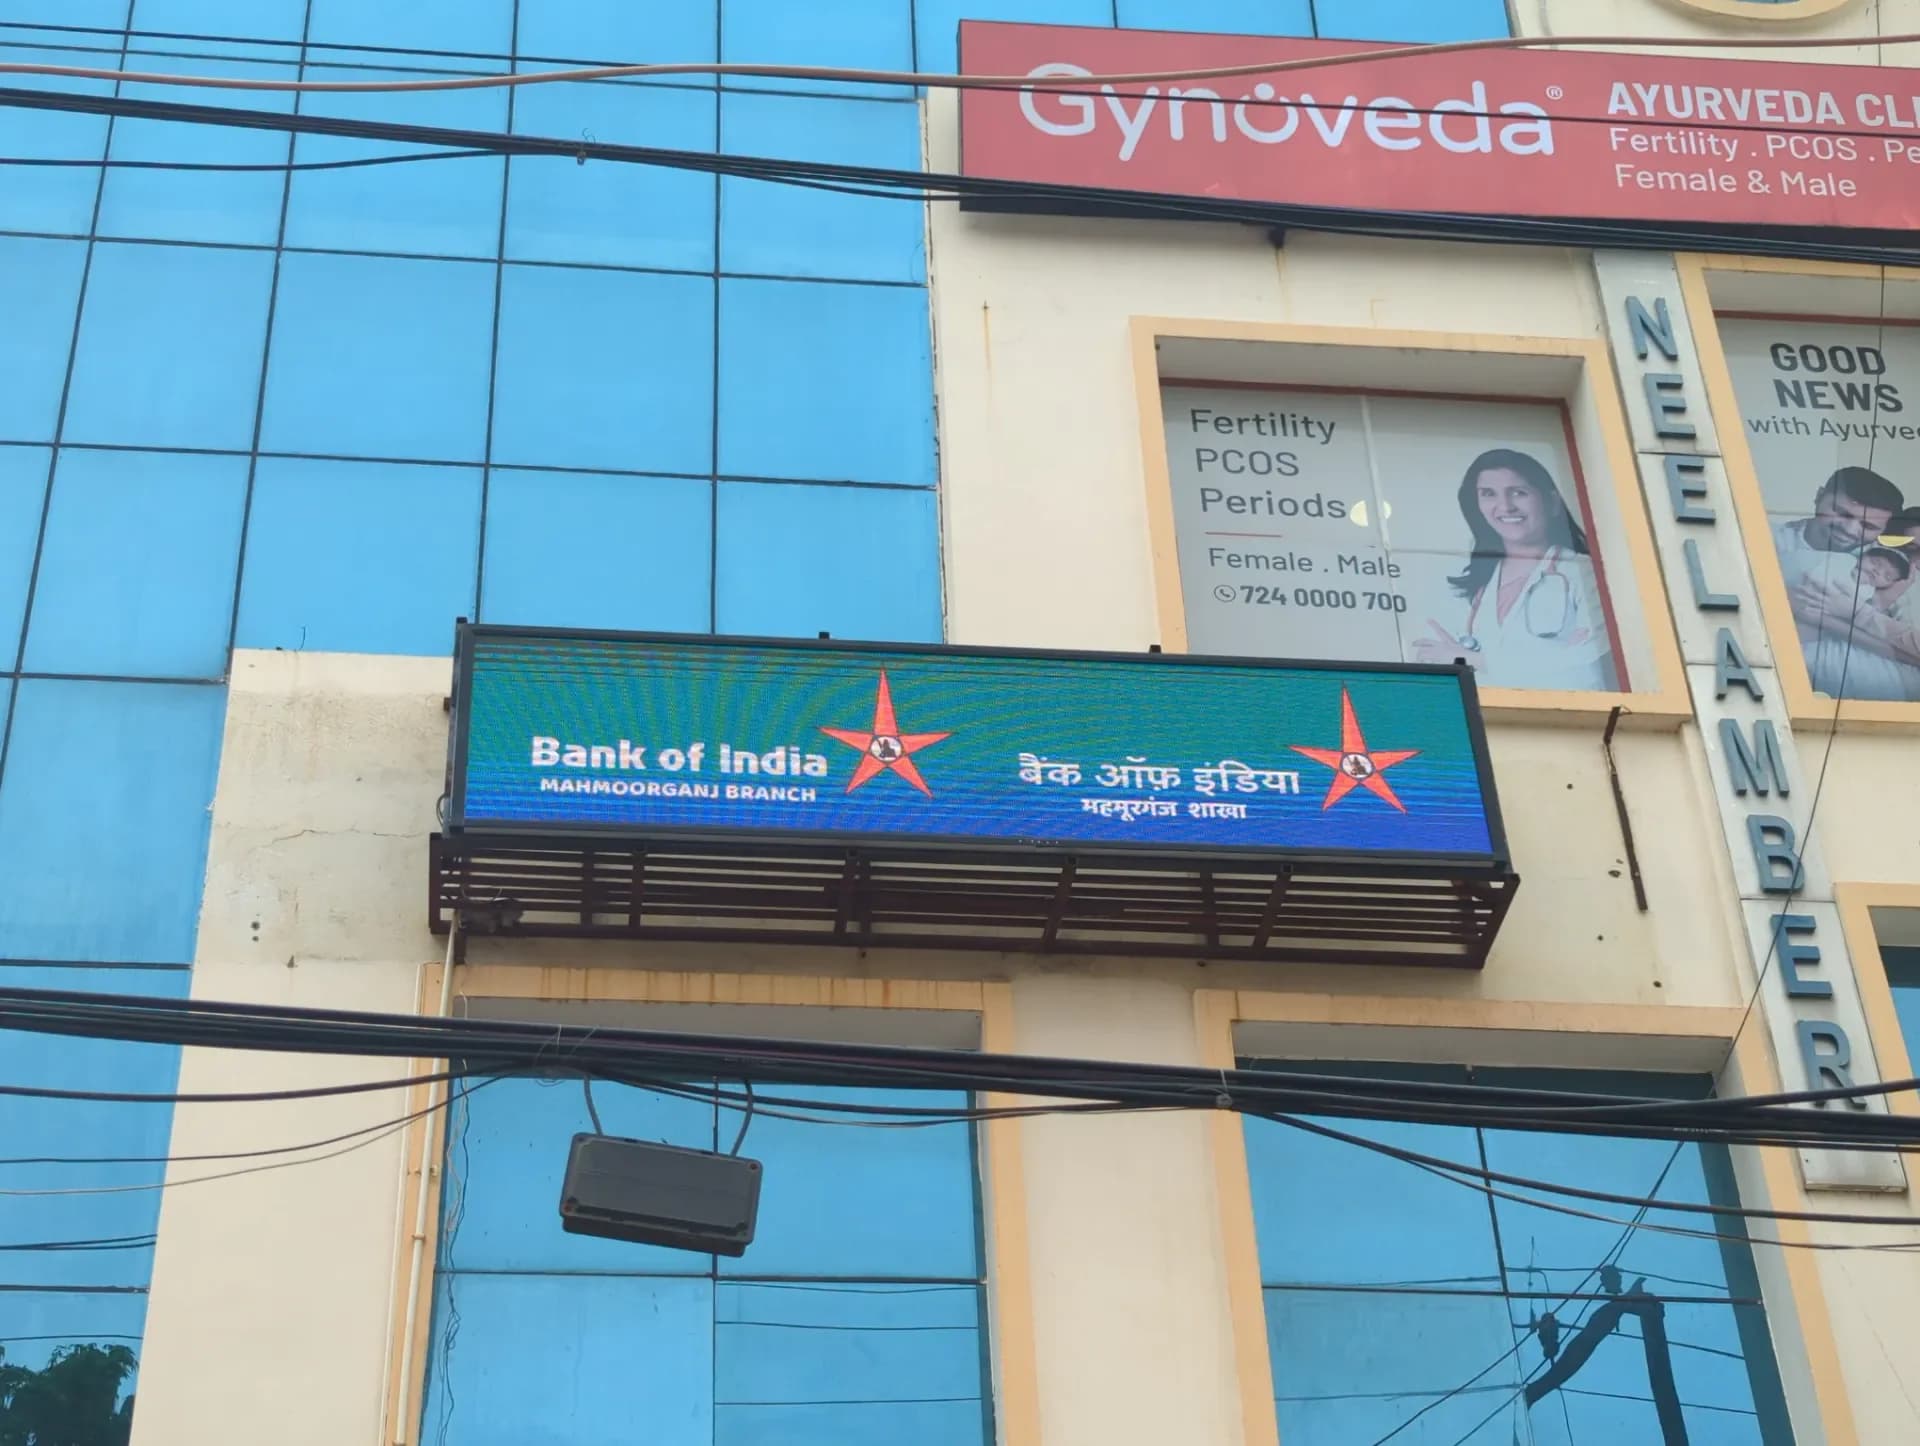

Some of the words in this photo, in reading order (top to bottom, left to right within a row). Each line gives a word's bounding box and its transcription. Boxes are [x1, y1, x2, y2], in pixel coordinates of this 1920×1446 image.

[1607, 82, 1845, 125] AYURVEDA
[1609, 128, 1739, 162] Fertility
[1766, 134, 1857, 161] PCOS
[1615, 163, 1737, 193] Female
[1747, 170, 1771, 194] &
[1781, 171, 1857, 197] Male
[1770, 343, 1886, 376] GOOD
[1773, 378, 1903, 413] NEWS
[1190, 409, 1336, 444] Fertility
[1748, 416, 1810, 436] with
[1820, 417, 1920, 442] Ayurve
[1195, 448, 1300, 477] PCOS
[1200, 488, 1346, 519] Periods
[1208, 548, 1313, 573] Female
[1337, 554, 1401, 578] Male
[1239, 585, 1287, 606] 724
[1294, 588, 1357, 610] 0000
[1361, 592, 1407, 613] 700
[531, 736, 647, 771] Bank
[658, 743, 705, 771] of
[719, 744, 828, 778] India
[540, 778, 719, 800] MAHMOORGANJ
[726, 784, 816, 803] BRANCH
[1018, 753, 1082, 786] बैंक
[1192, 760, 1301, 797] इंडिया
[1187, 802, 1247, 820] शाखा
